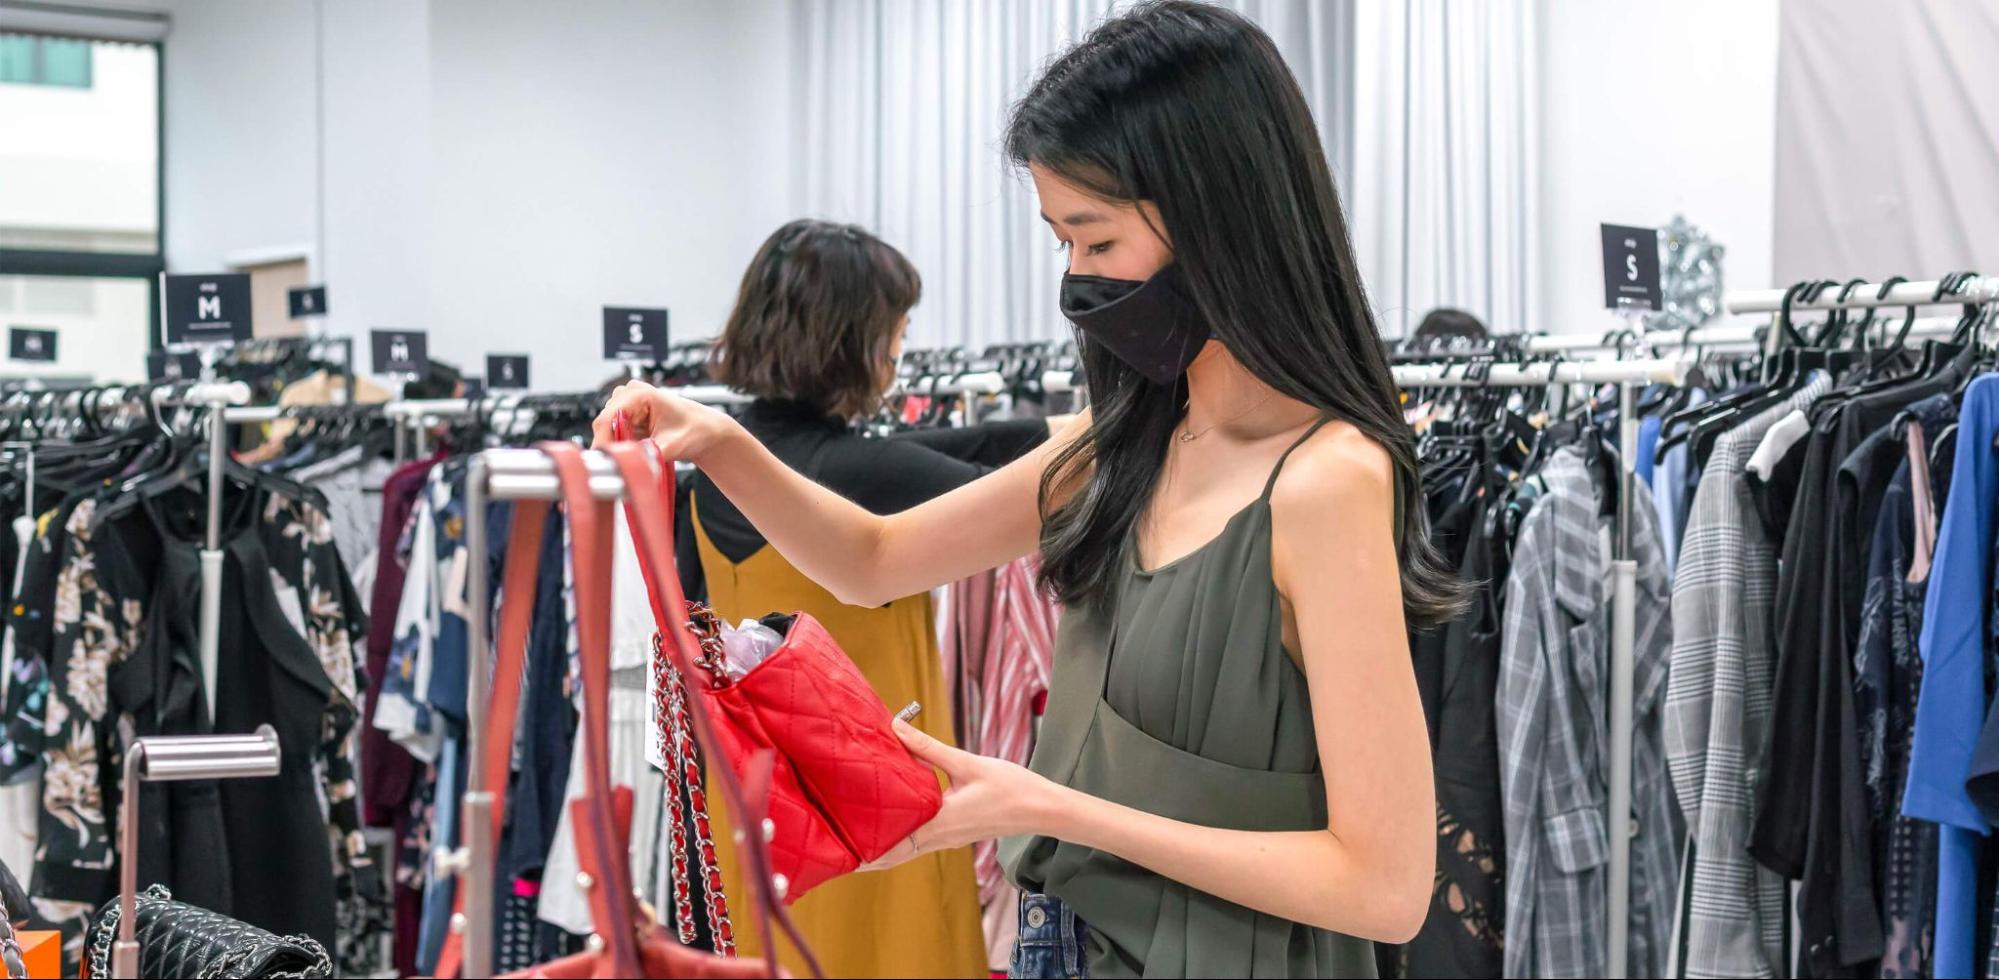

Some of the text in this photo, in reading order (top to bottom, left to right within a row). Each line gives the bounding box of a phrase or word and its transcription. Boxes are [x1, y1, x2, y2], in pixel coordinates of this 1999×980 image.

[1626, 254, 1638, 281] S
[198, 296, 221, 319] M
[629, 323, 643, 343] S
